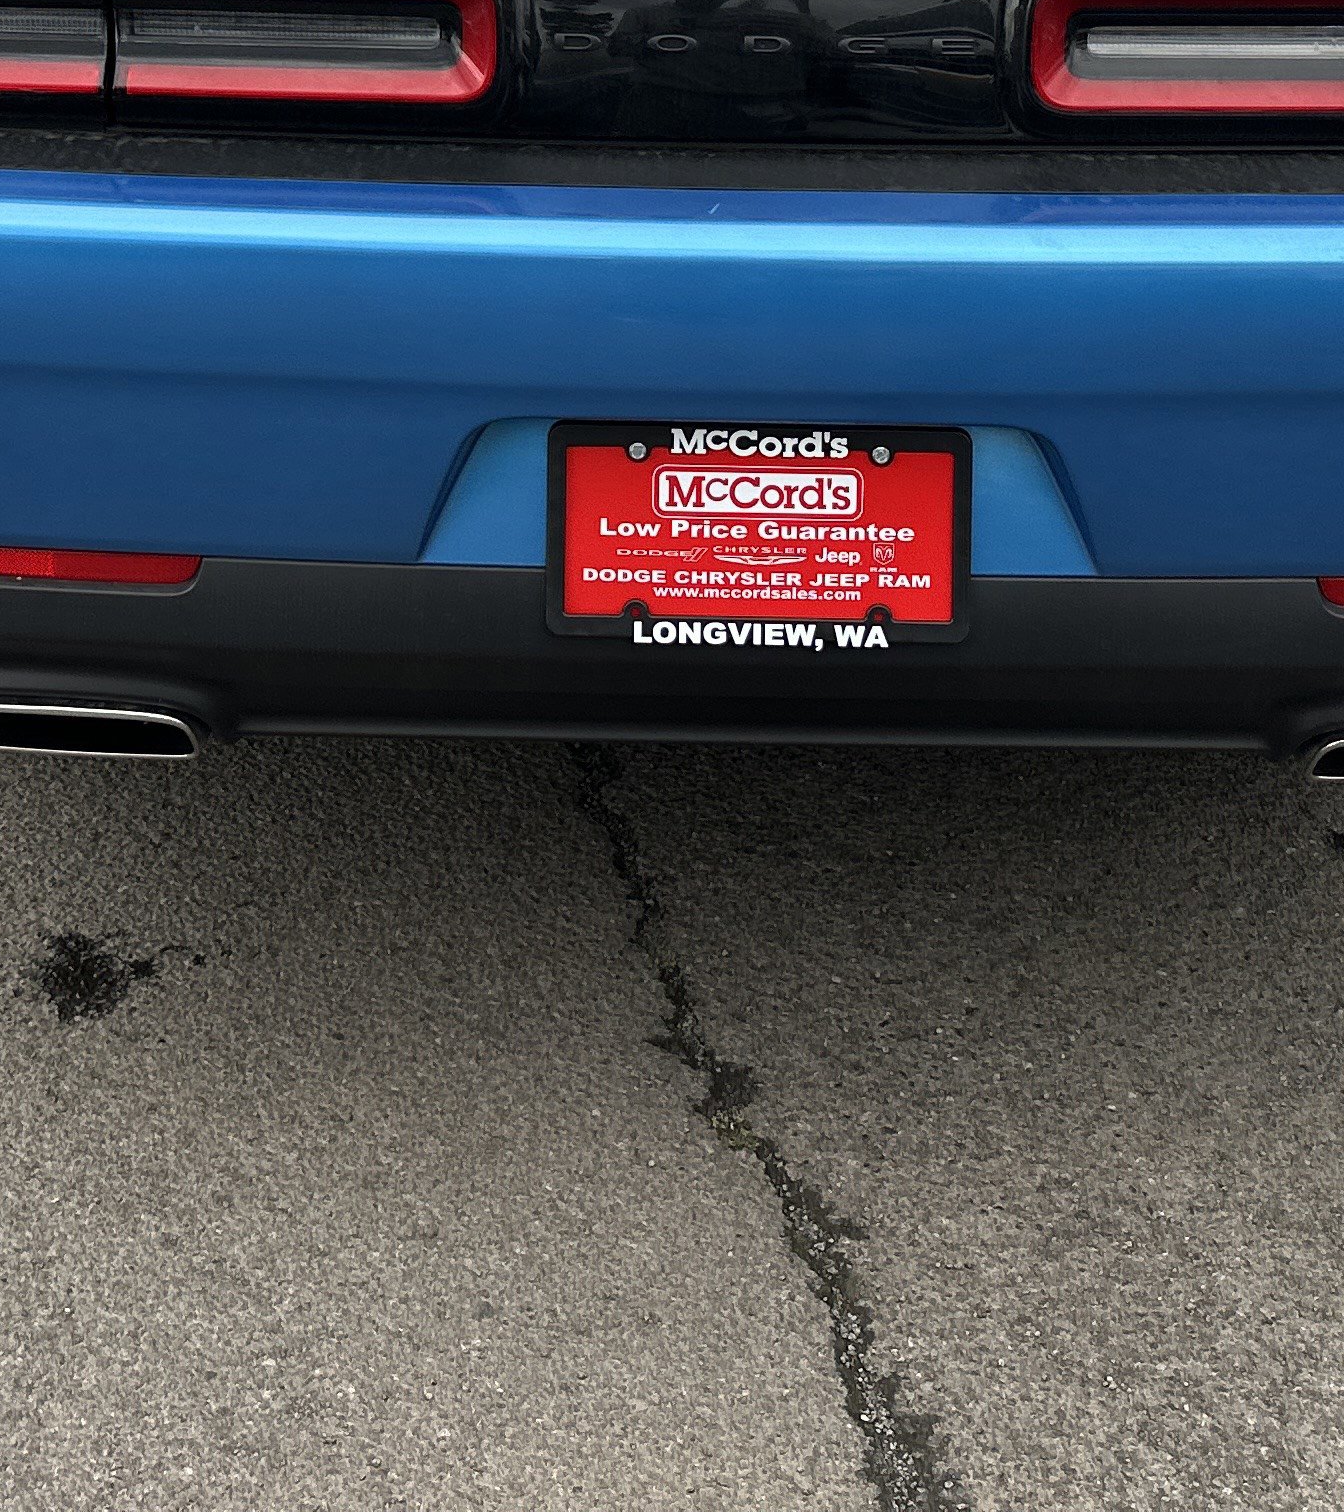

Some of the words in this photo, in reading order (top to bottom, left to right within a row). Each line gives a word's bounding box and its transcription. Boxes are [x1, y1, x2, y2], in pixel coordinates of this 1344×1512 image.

[552, 31, 980, 56] DODGE
[670, 428, 849, 459] McCord's
[665, 475, 851, 510] McCord's
[599, 517, 662, 537] Low
[671, 519, 748, 539] Price
[757, 520, 916, 542] Guarantee
[615, 548, 693, 557] DODGE
[712, 545, 807, 554] CHRYSLER
[814, 546, 861, 566] Jeep
[582, 567, 667, 584] DODGE
[673, 570, 803, 586] CHRYSLER
[809, 573, 870, 587] JEEP
[878, 574, 931, 589] RAM
[653, 586, 861, 601] www.mccordsales.com
[633, 621, 824, 652] LONGVIEW,
[834, 624, 889, 648] WA
